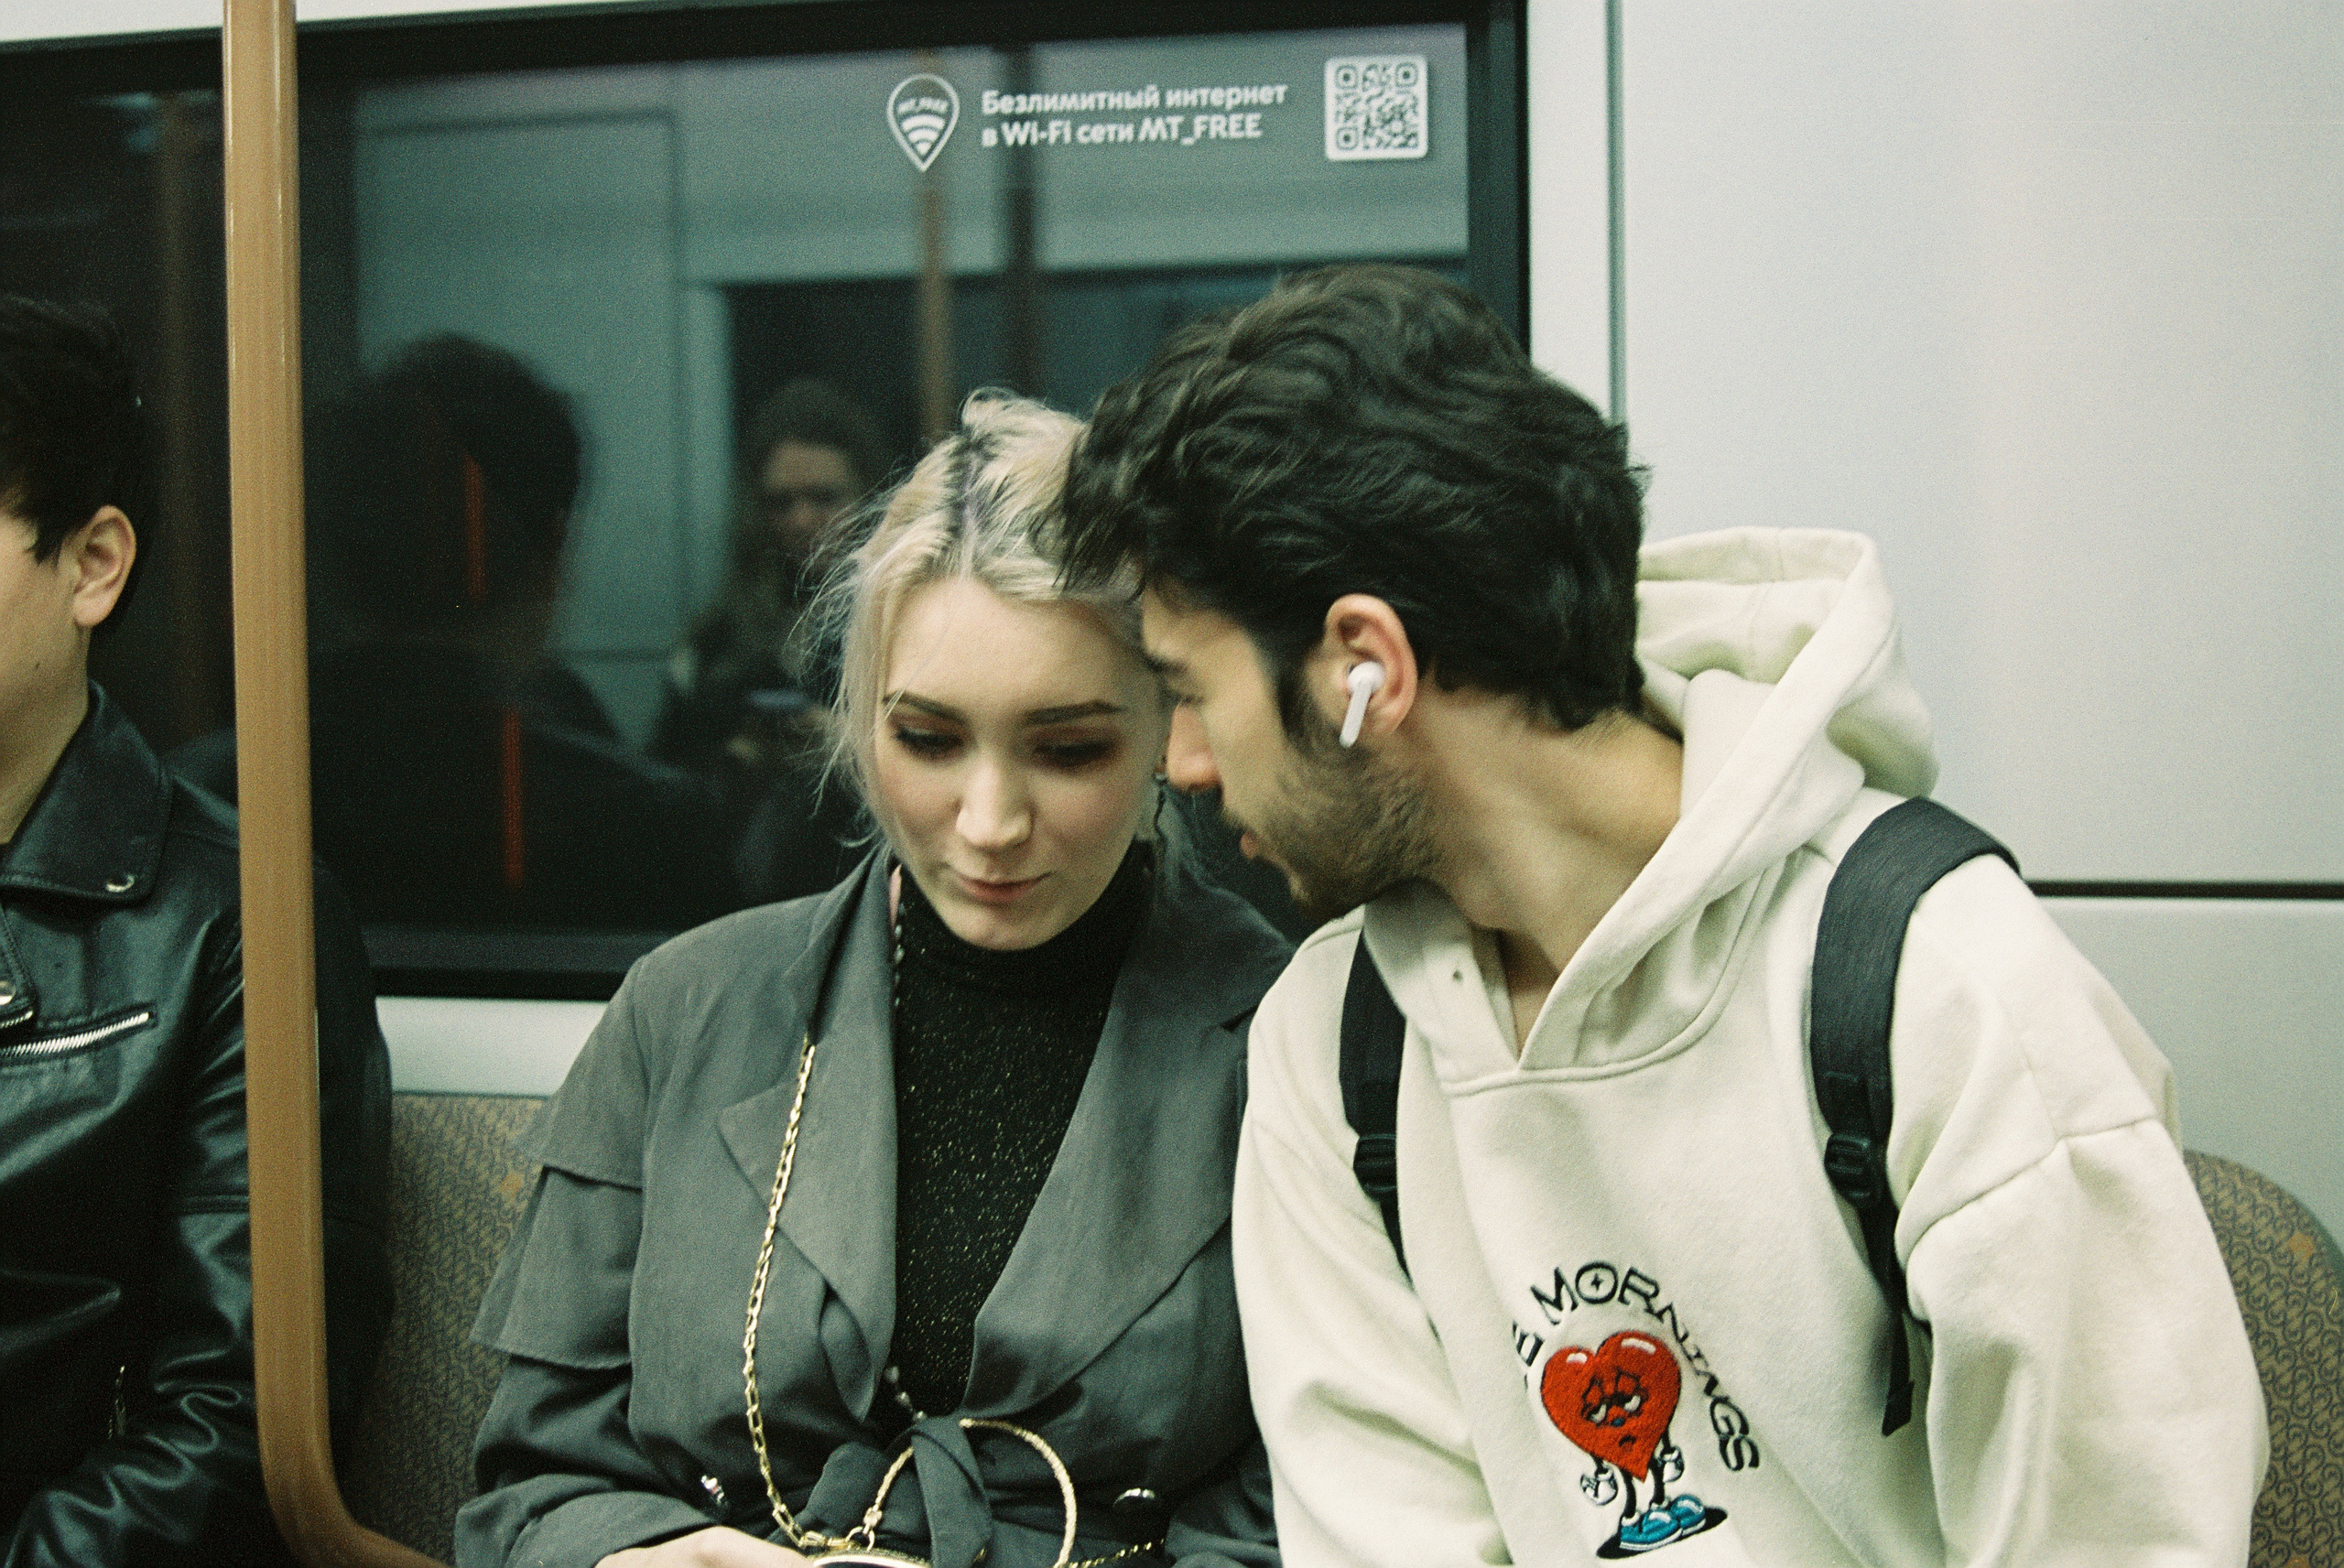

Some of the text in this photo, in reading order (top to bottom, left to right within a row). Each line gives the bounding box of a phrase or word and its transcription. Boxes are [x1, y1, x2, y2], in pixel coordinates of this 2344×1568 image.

[982, 85, 1161, 114] Безлимитный
[1166, 84, 1287, 111] интернет
[982, 128, 998, 146] в
[1077, 124, 1134, 144] сети
[1138, 113, 1263, 146] MT_FREE
[1530, 1260, 1760, 1472] MORNINGS
